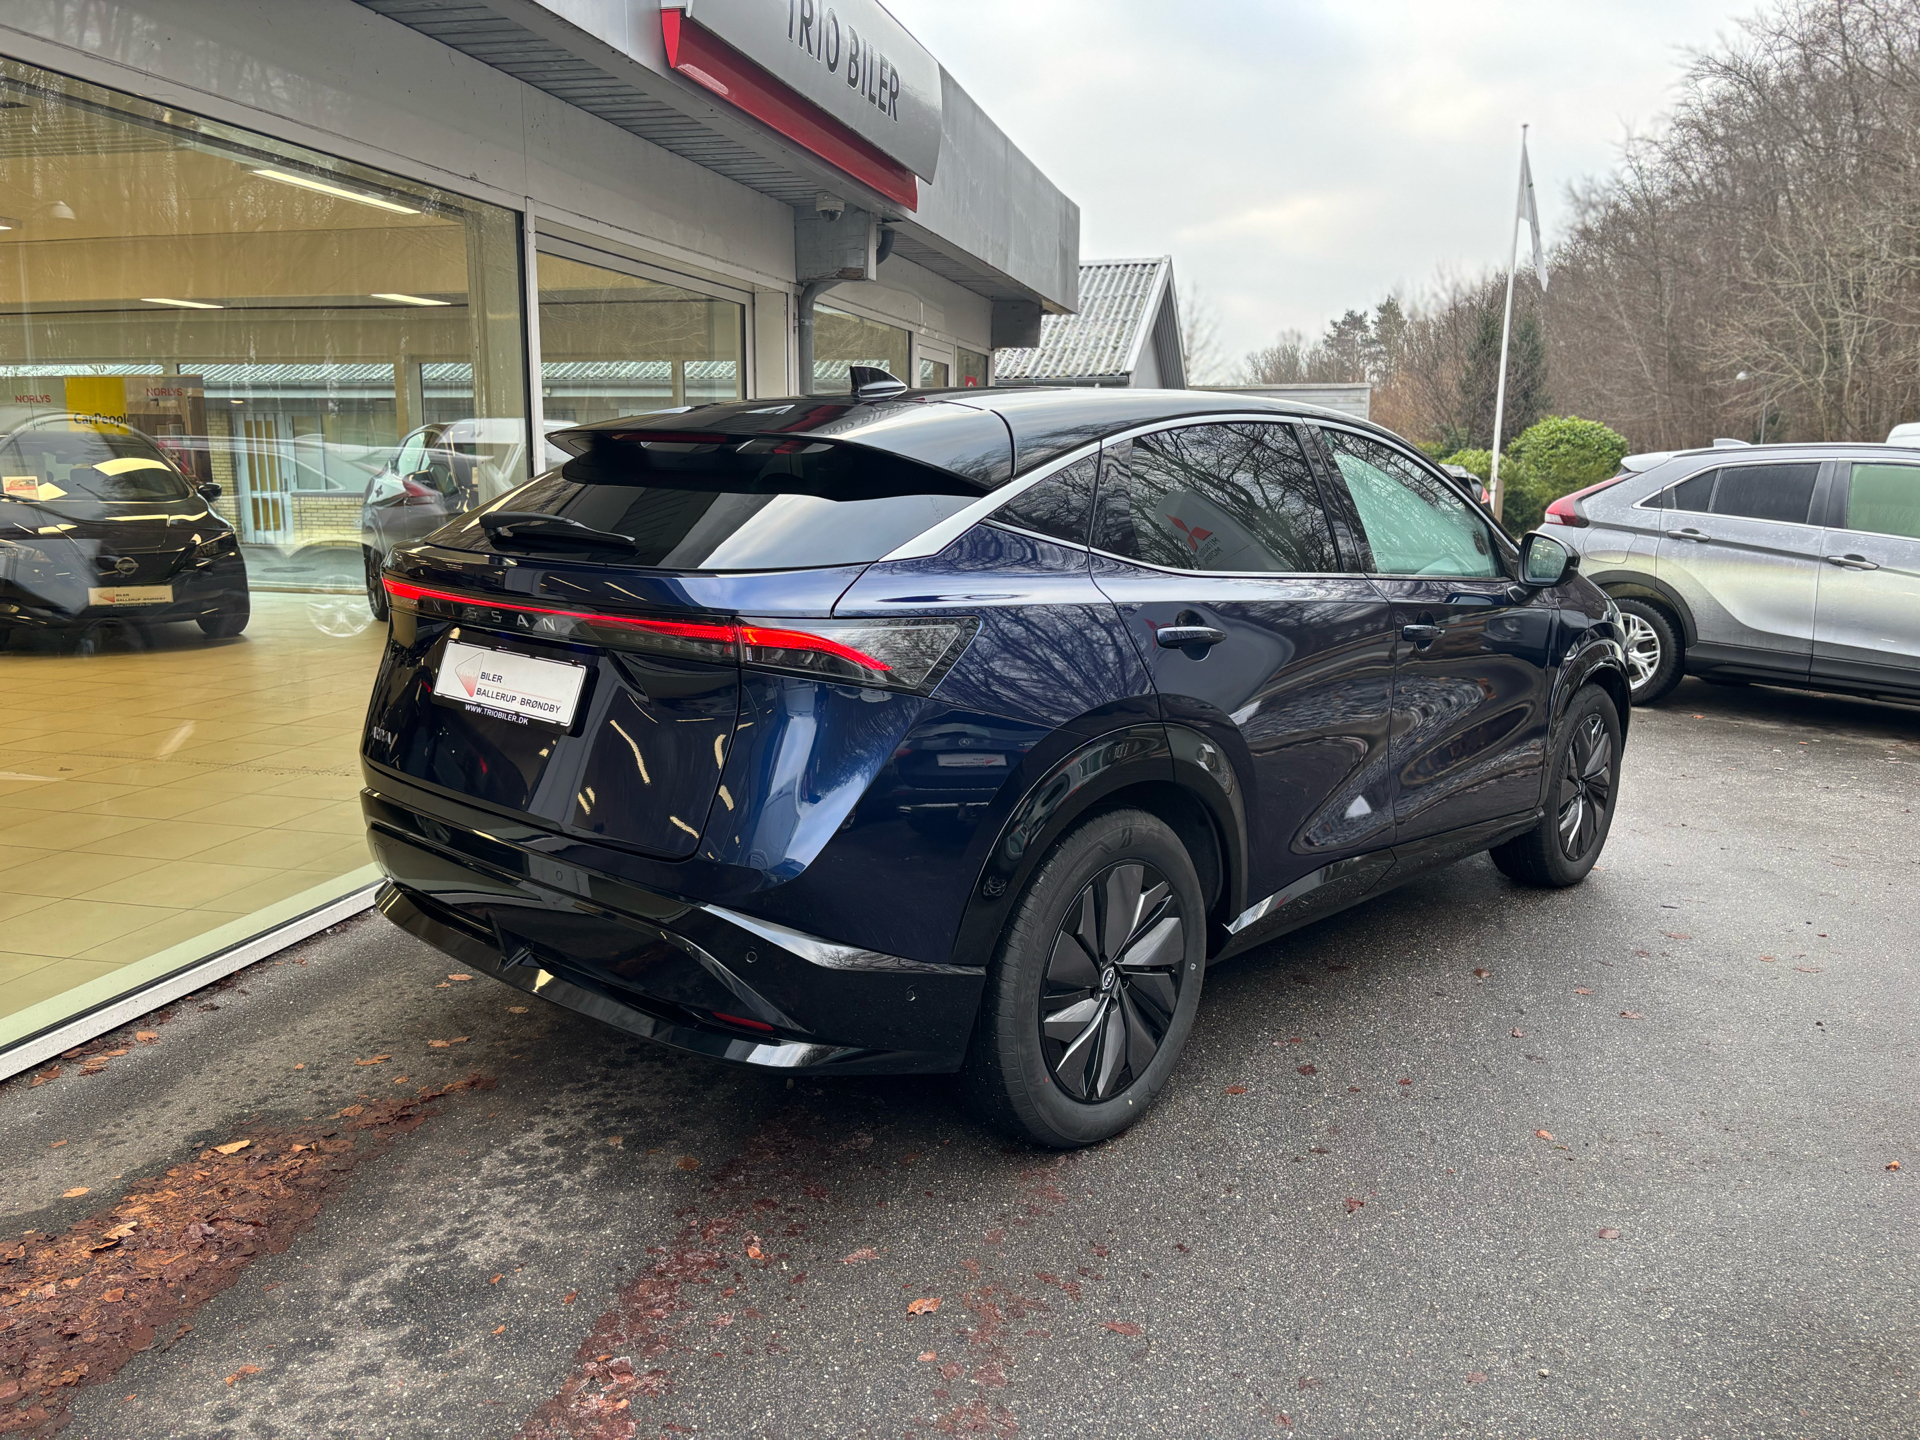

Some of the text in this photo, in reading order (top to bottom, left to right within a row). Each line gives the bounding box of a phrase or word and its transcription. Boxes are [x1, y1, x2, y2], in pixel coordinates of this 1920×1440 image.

[846, 24, 900, 124] BILER
[15, 394, 51, 403] NORLYS
[146, 387, 183, 397] NORLYS
[73, 412, 128, 428] CarPeopl
[432, 600, 556, 632] NISSAN
[480, 671, 503, 684] BILER
[476, 687, 562, 714] BALLERUP BRØNDBY
[464, 703, 529, 726] WWW.TRIOBILER.DK
